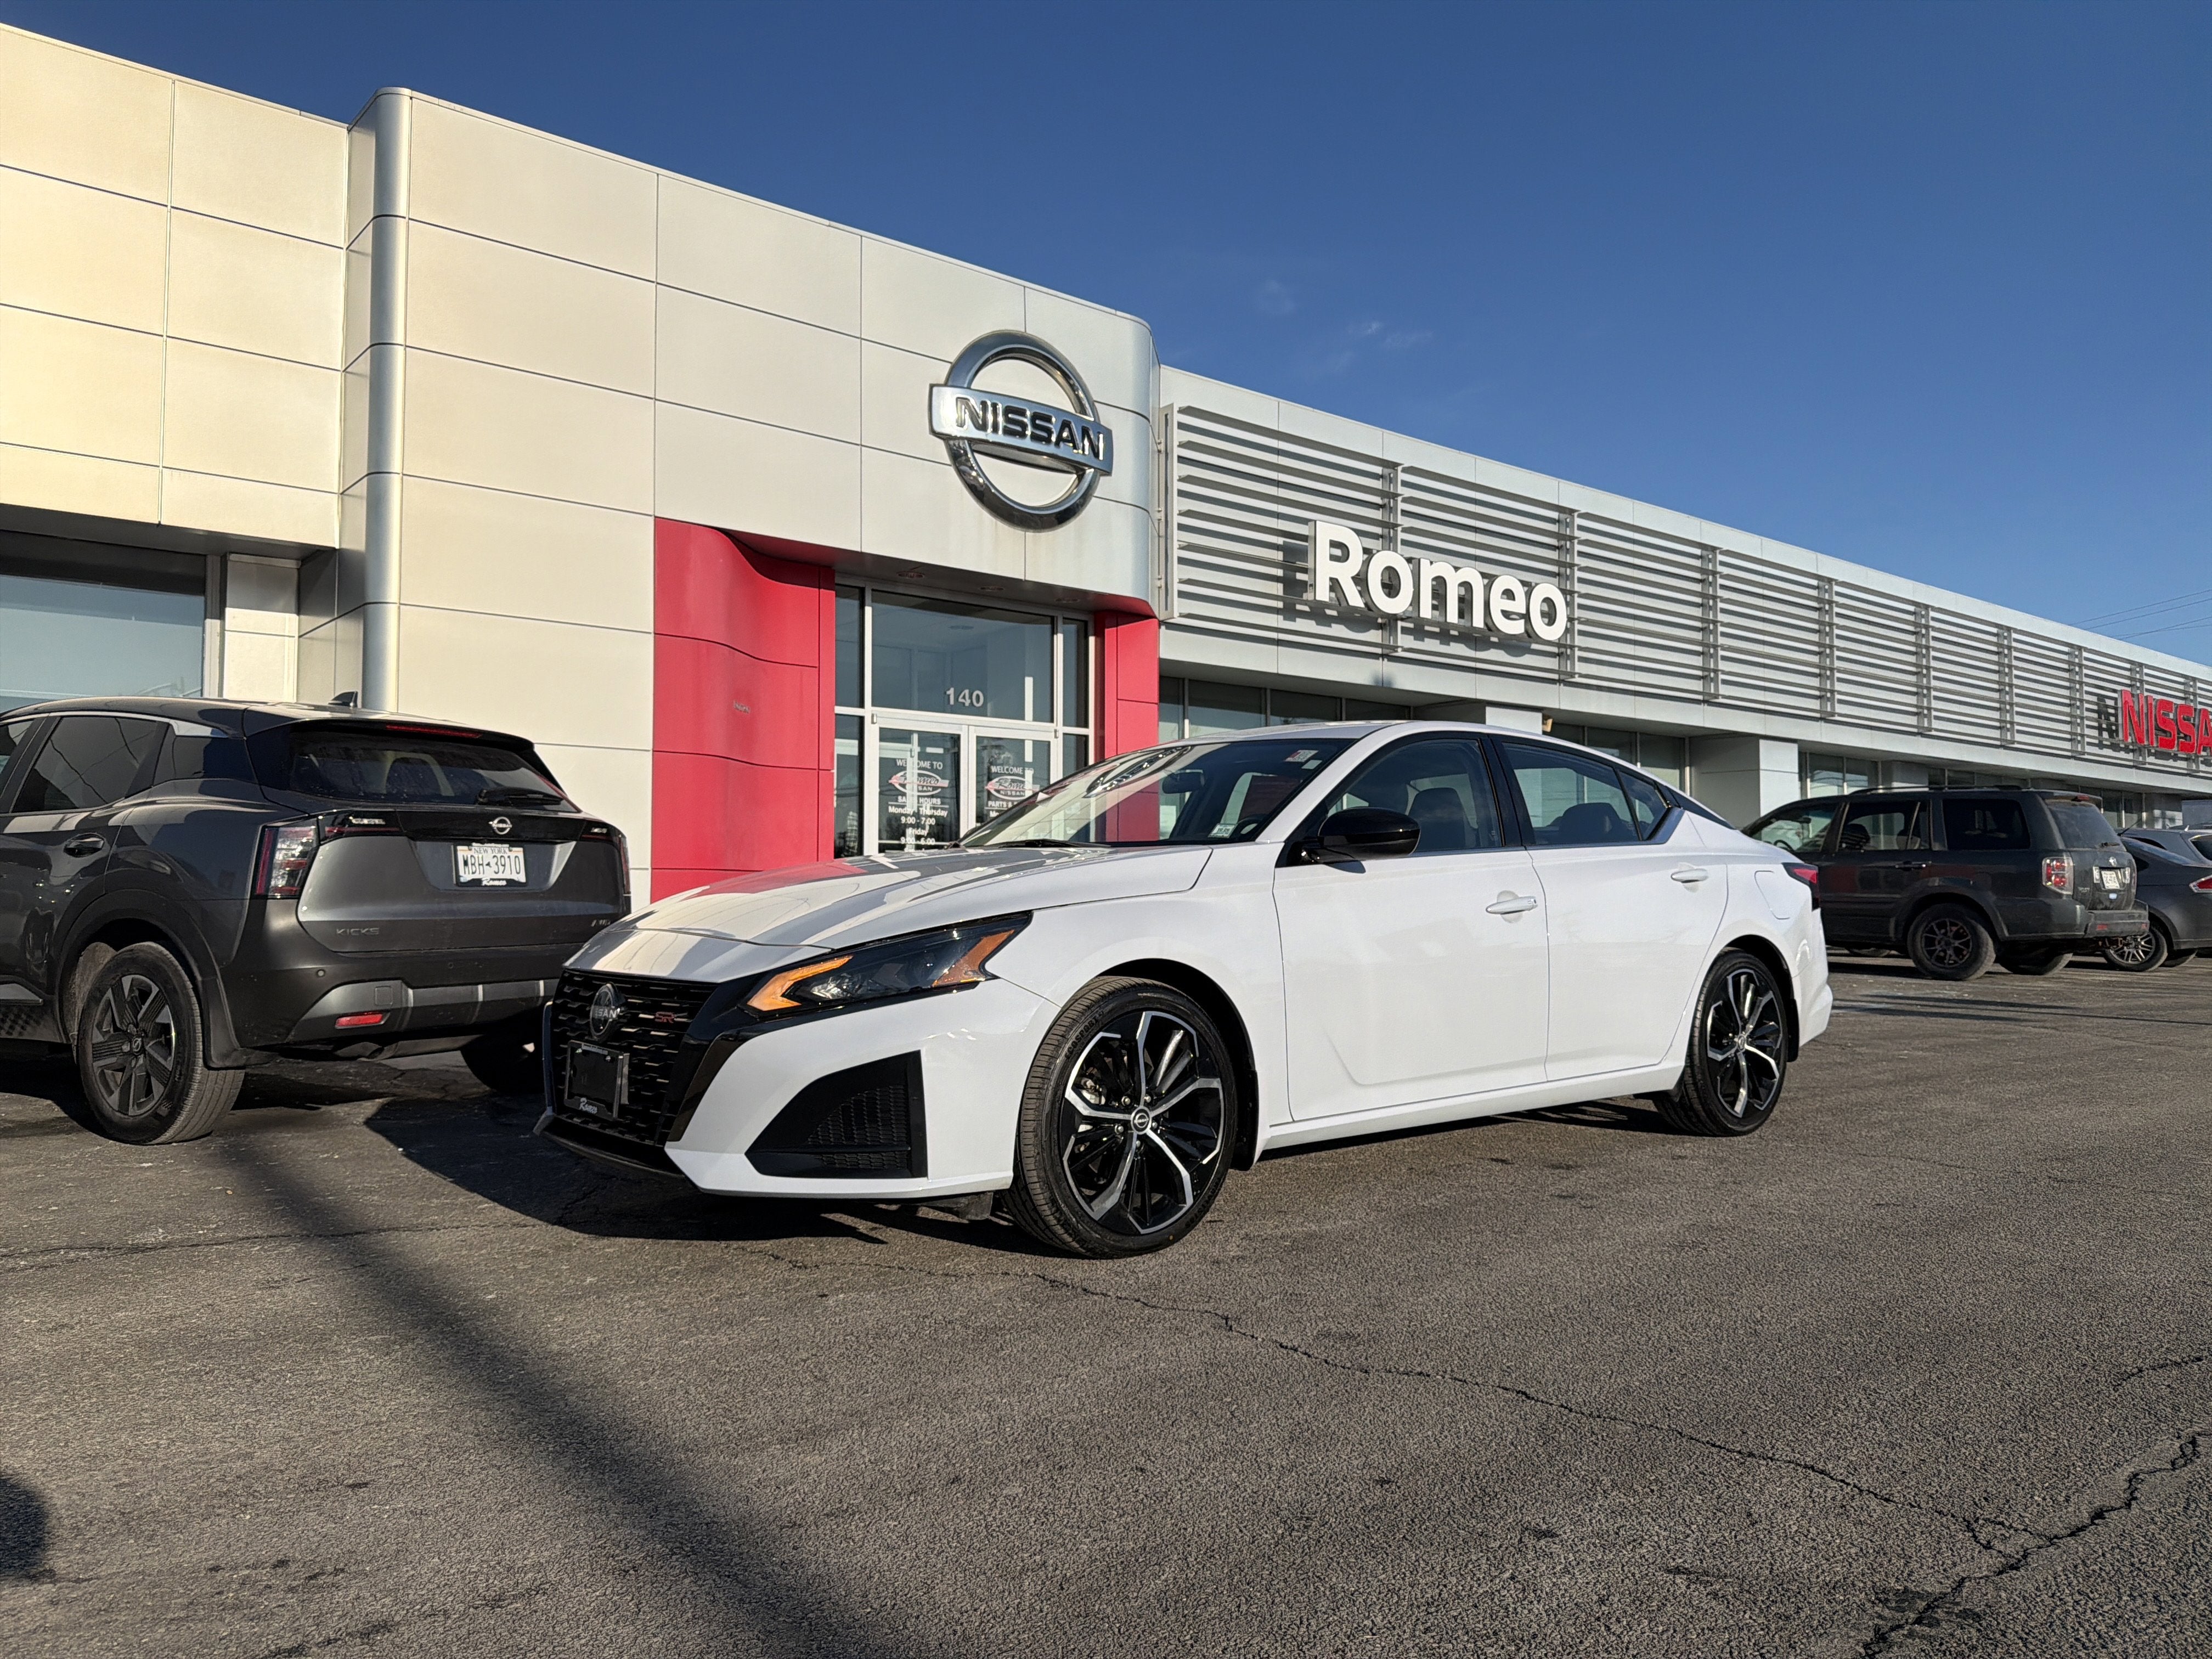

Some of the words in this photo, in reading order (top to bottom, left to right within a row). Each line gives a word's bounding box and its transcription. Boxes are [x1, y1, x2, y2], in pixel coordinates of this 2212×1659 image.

[955, 394, 1104, 460] NISSAN
[1311, 520, 1567, 640] Romeo
[946, 687, 984, 707] 140
[896, 759, 932, 769] WEOME
[932, 761, 943, 770] TO
[990, 765, 1023, 775] WELCOME
[889, 805, 914, 815] Monday
[900, 816, 916, 824] 9:00
[921, 817, 935, 825] 7:00
[909, 827, 928, 837] Friday
[493, 855, 521, 875] 3910
[336, 928, 379, 936] KICKS
[654, 1012, 674, 1024] SR
